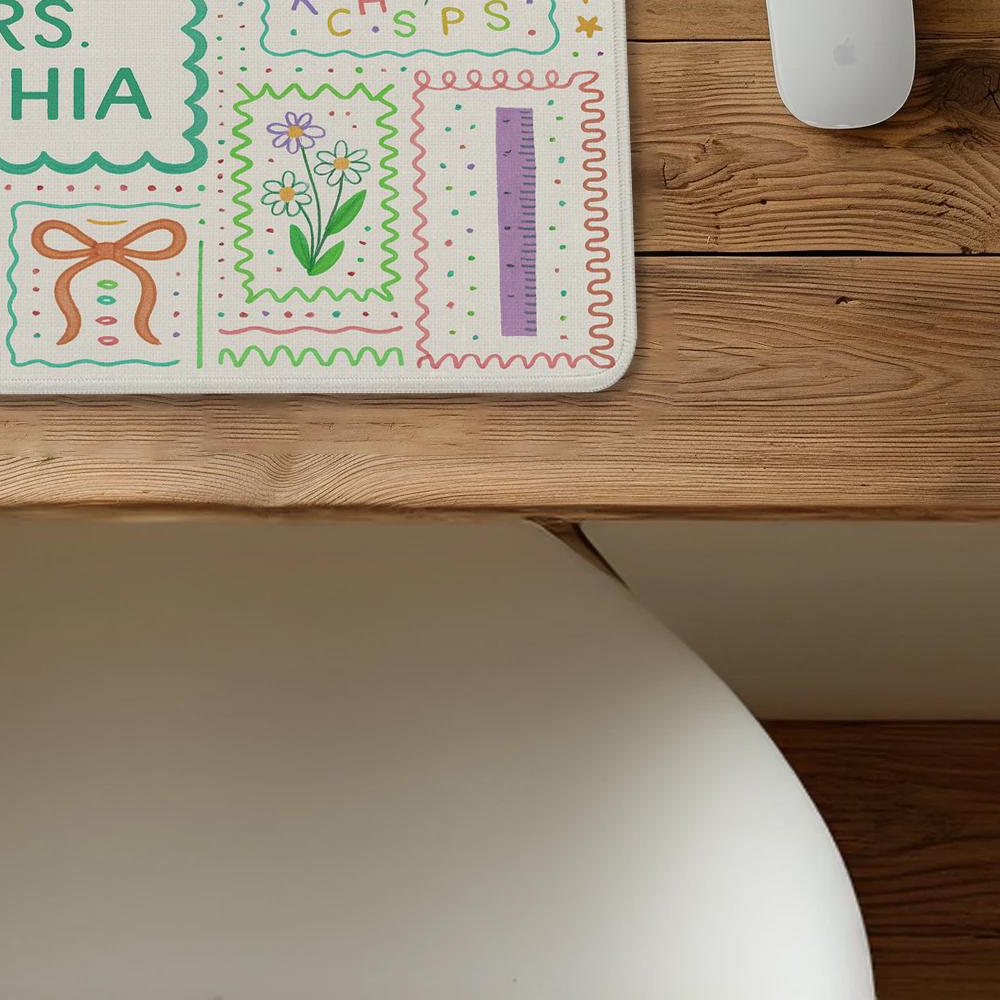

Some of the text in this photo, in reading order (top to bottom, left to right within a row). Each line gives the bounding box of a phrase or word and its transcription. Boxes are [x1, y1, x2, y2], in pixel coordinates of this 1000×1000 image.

[326, 7, 352, 37] C
[392, 9, 417, 38] S
[440, 6, 465, 36] P
[483, 0, 511, 32] S
